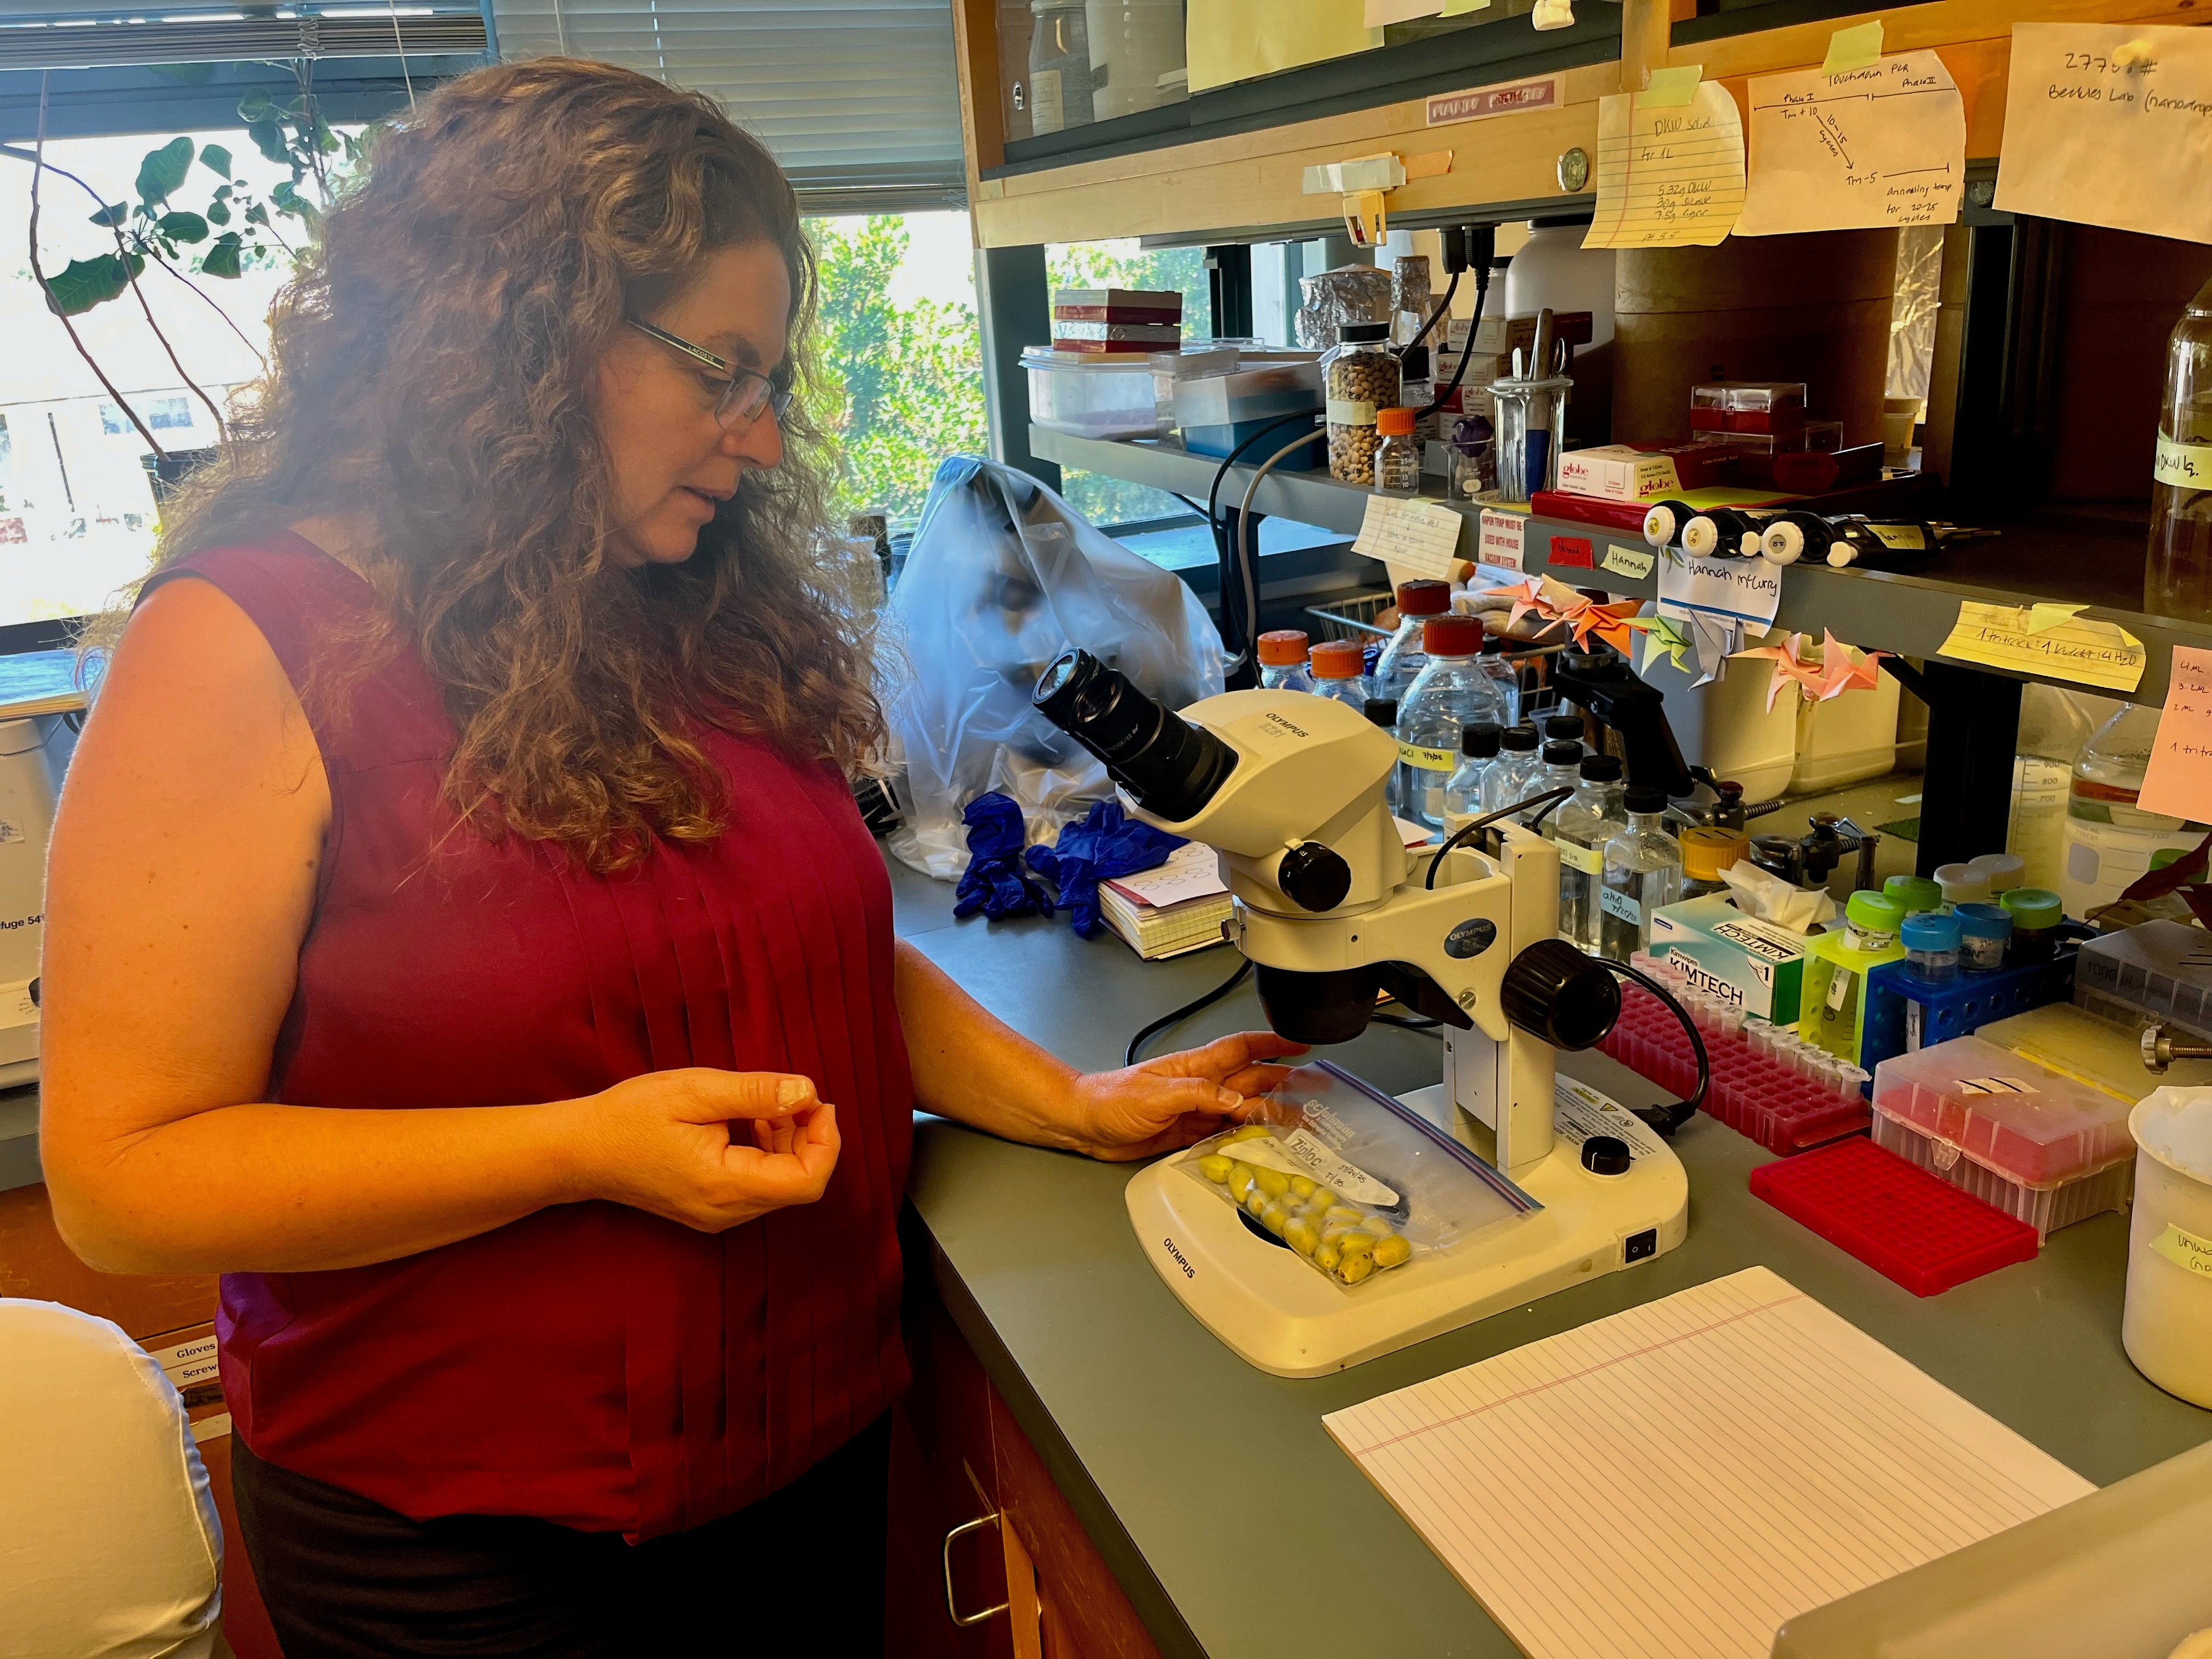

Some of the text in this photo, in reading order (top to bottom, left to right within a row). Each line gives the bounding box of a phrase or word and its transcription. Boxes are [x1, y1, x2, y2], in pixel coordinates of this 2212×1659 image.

[1891, 64, 1909, 75] PCR
[2109, 88, 2134, 101] Lab
[1655, 117, 1682, 137] DKW
[1562, 463, 1588, 479] globe
[1639, 478, 1674, 499] globe
[1482, 515, 1522, 531] VAPOR TRAP MUST BE
[1485, 534, 1519, 549] USED WITH HOUSE
[1485, 553, 1516, 568] VACUUM SYSTEM
[1612, 550, 1647, 572] Hannah
[1689, 559, 1777, 597] Hannah McCurry
[1266, 713, 1309, 738] OLYMPUS
[0, 921, 24, 930] fuge
[1449, 924, 1492, 941] OLYMPUS
[1713, 926, 1789, 959] KIMTECH
[1671, 948, 1699, 967] Kimwipes
[1670, 957, 1743, 1005] KIMTECH
[1290, 1138, 1322, 1166] Ziploc
[1164, 1238, 1195, 1278] OLYMPUS
[177, 1343, 216, 1358] Gloves
[183, 1363, 217, 1378] Screw
